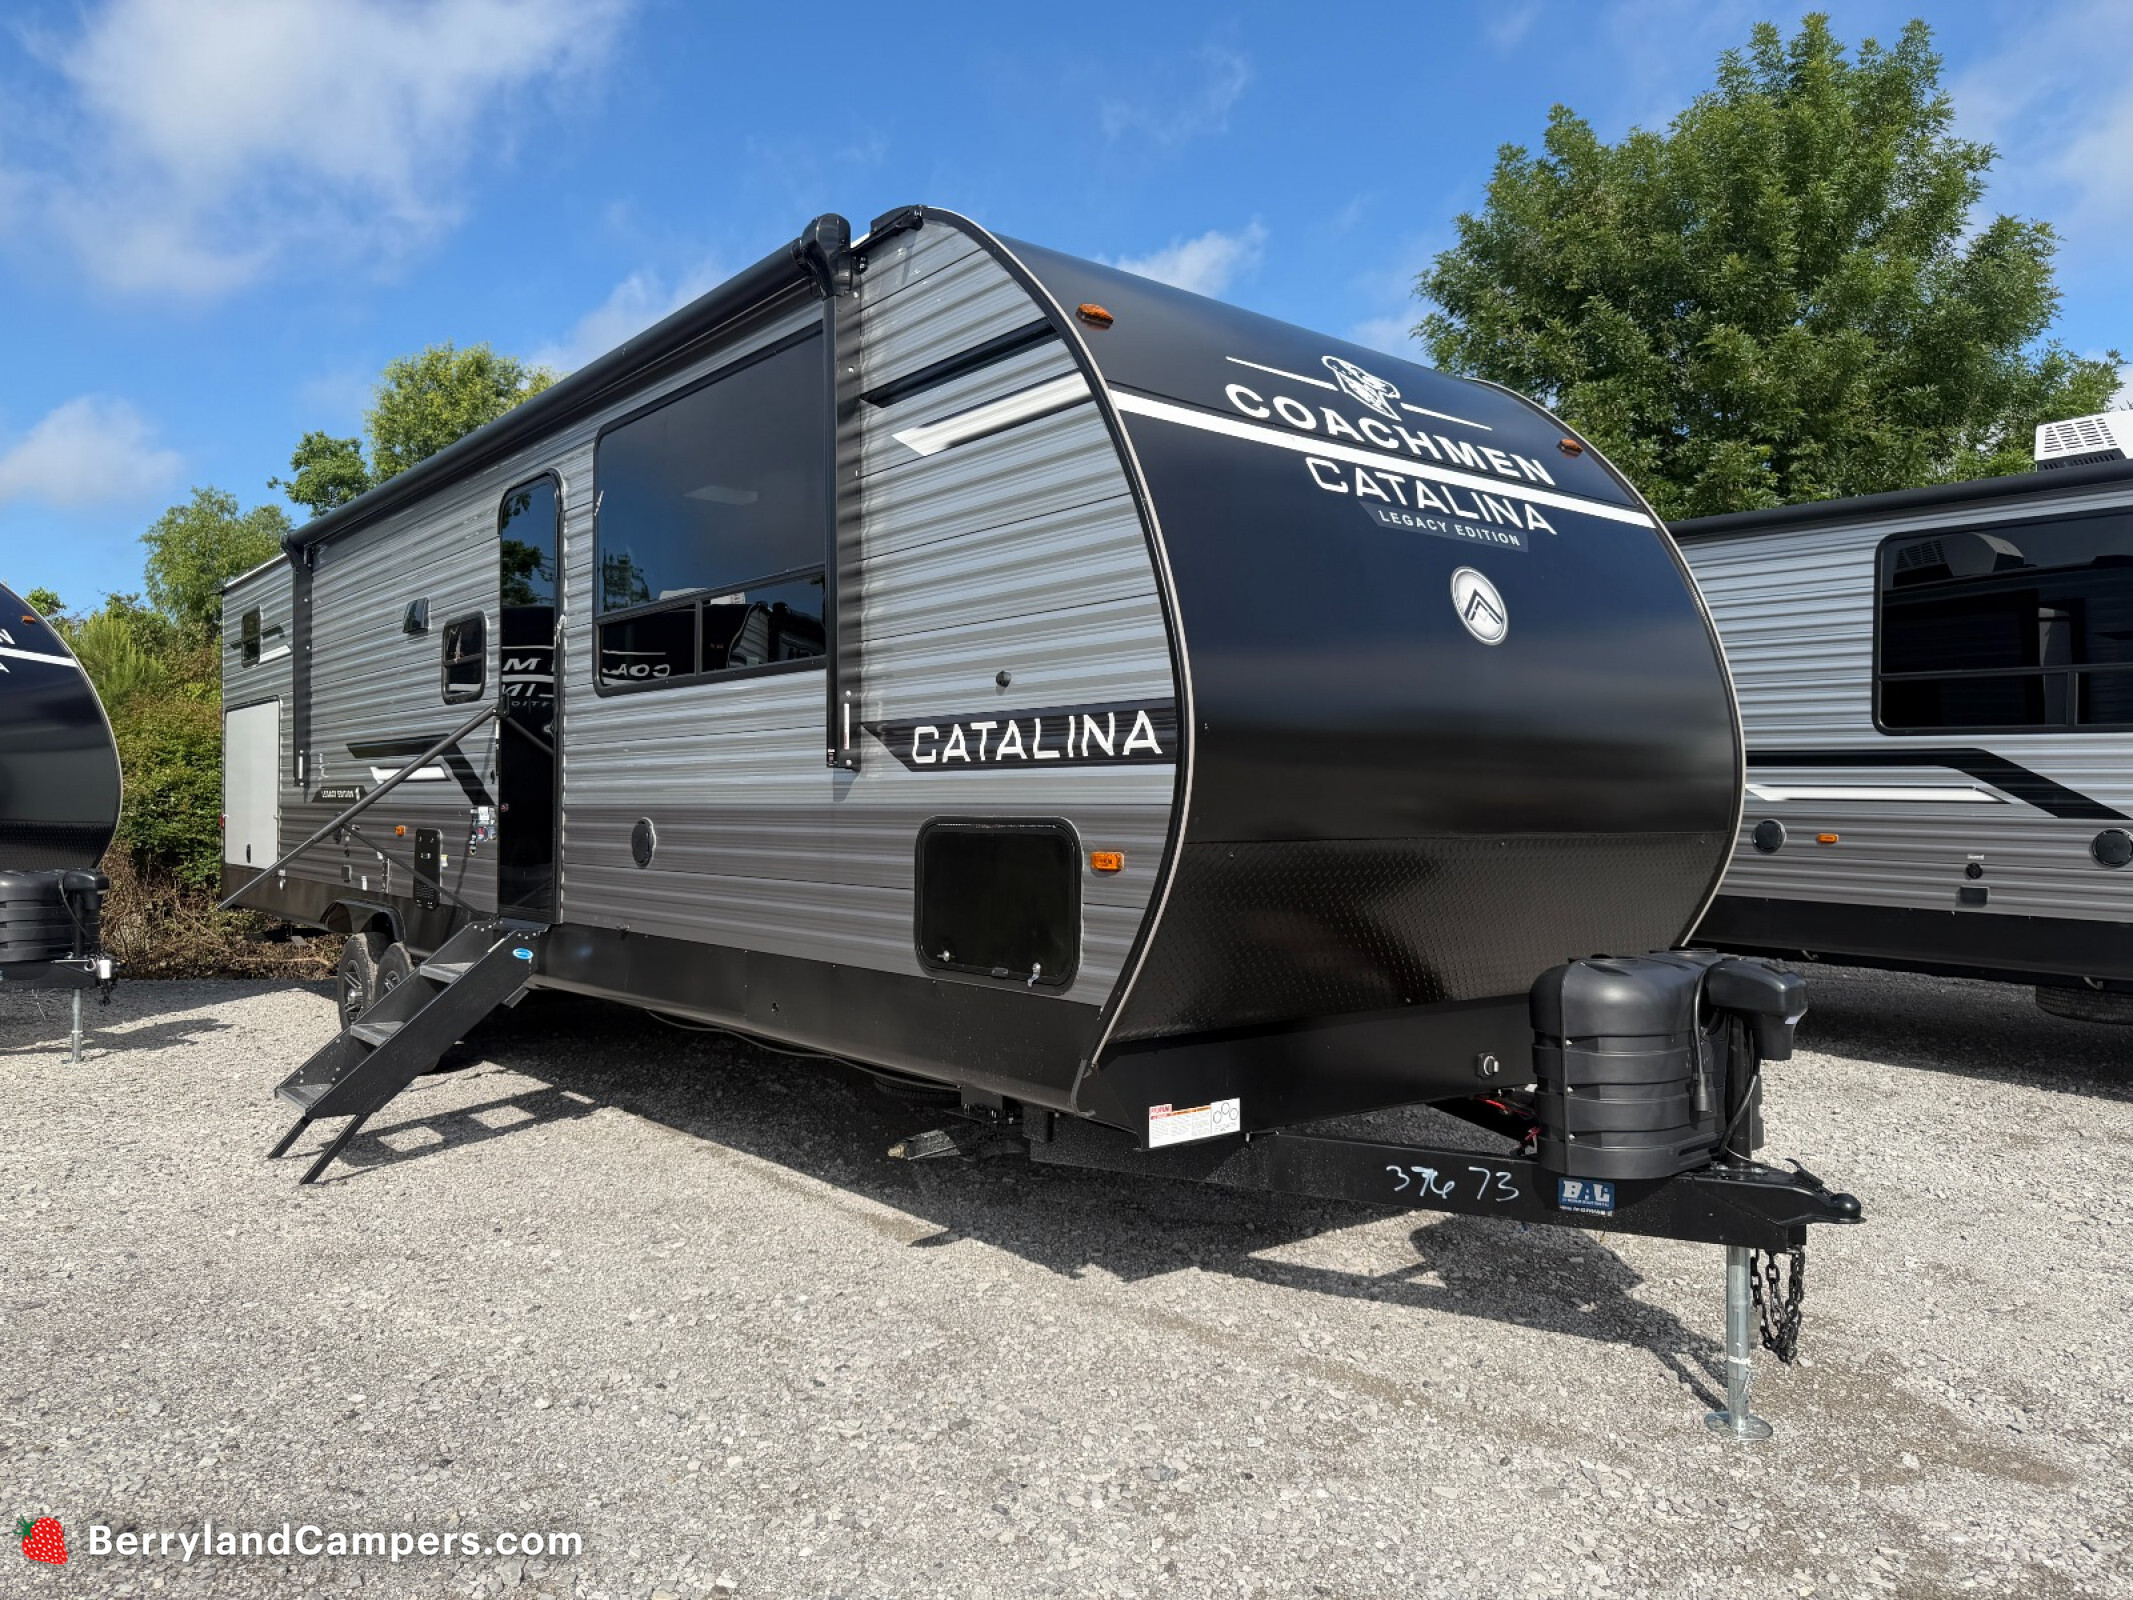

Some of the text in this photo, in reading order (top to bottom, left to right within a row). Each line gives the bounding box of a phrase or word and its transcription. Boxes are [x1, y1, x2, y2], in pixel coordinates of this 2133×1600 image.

[1225, 383, 1556, 487] COACHMEN
[1305, 456, 1558, 536] CATALINA
[1379, 510, 1521, 547] LEGACY EDITION
[911, 710, 1163, 764] CATALINA
